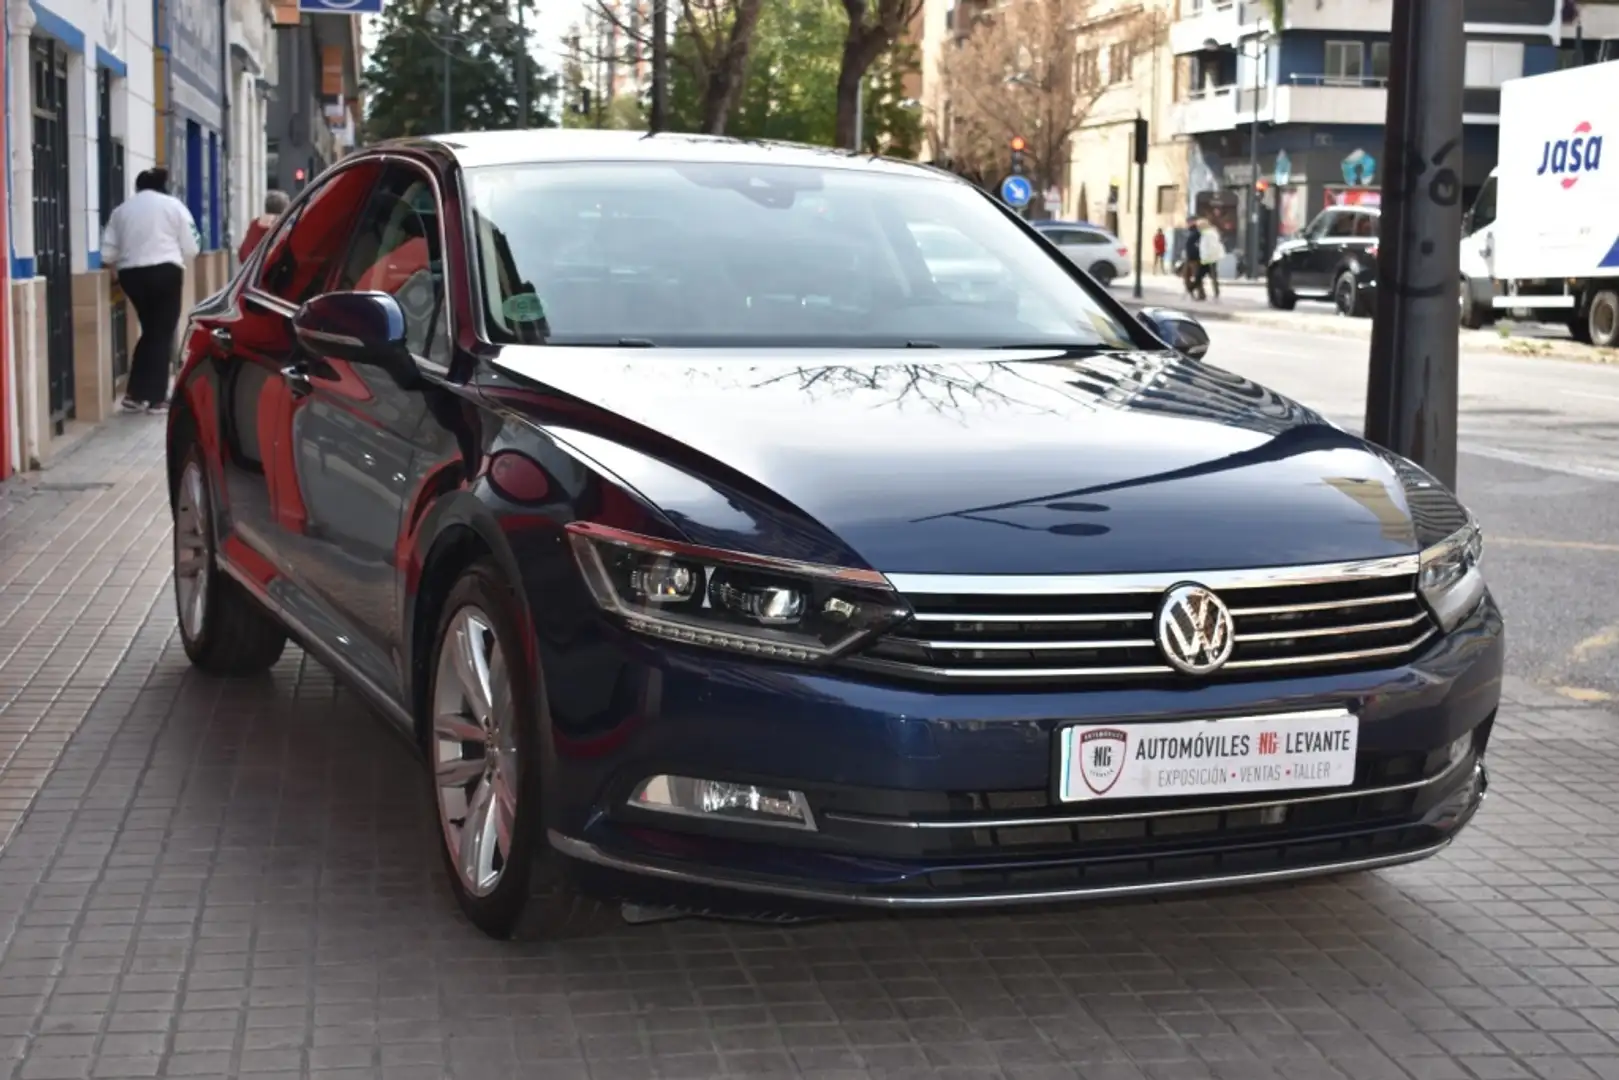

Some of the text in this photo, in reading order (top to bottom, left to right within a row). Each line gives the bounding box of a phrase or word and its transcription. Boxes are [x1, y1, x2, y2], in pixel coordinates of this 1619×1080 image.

[1135, 729, 1351, 760] AUTOMÓVILES NG LEVANTE
[1157, 762, 1331, 787] EXPOSICIÓN VENTAS TALLER
